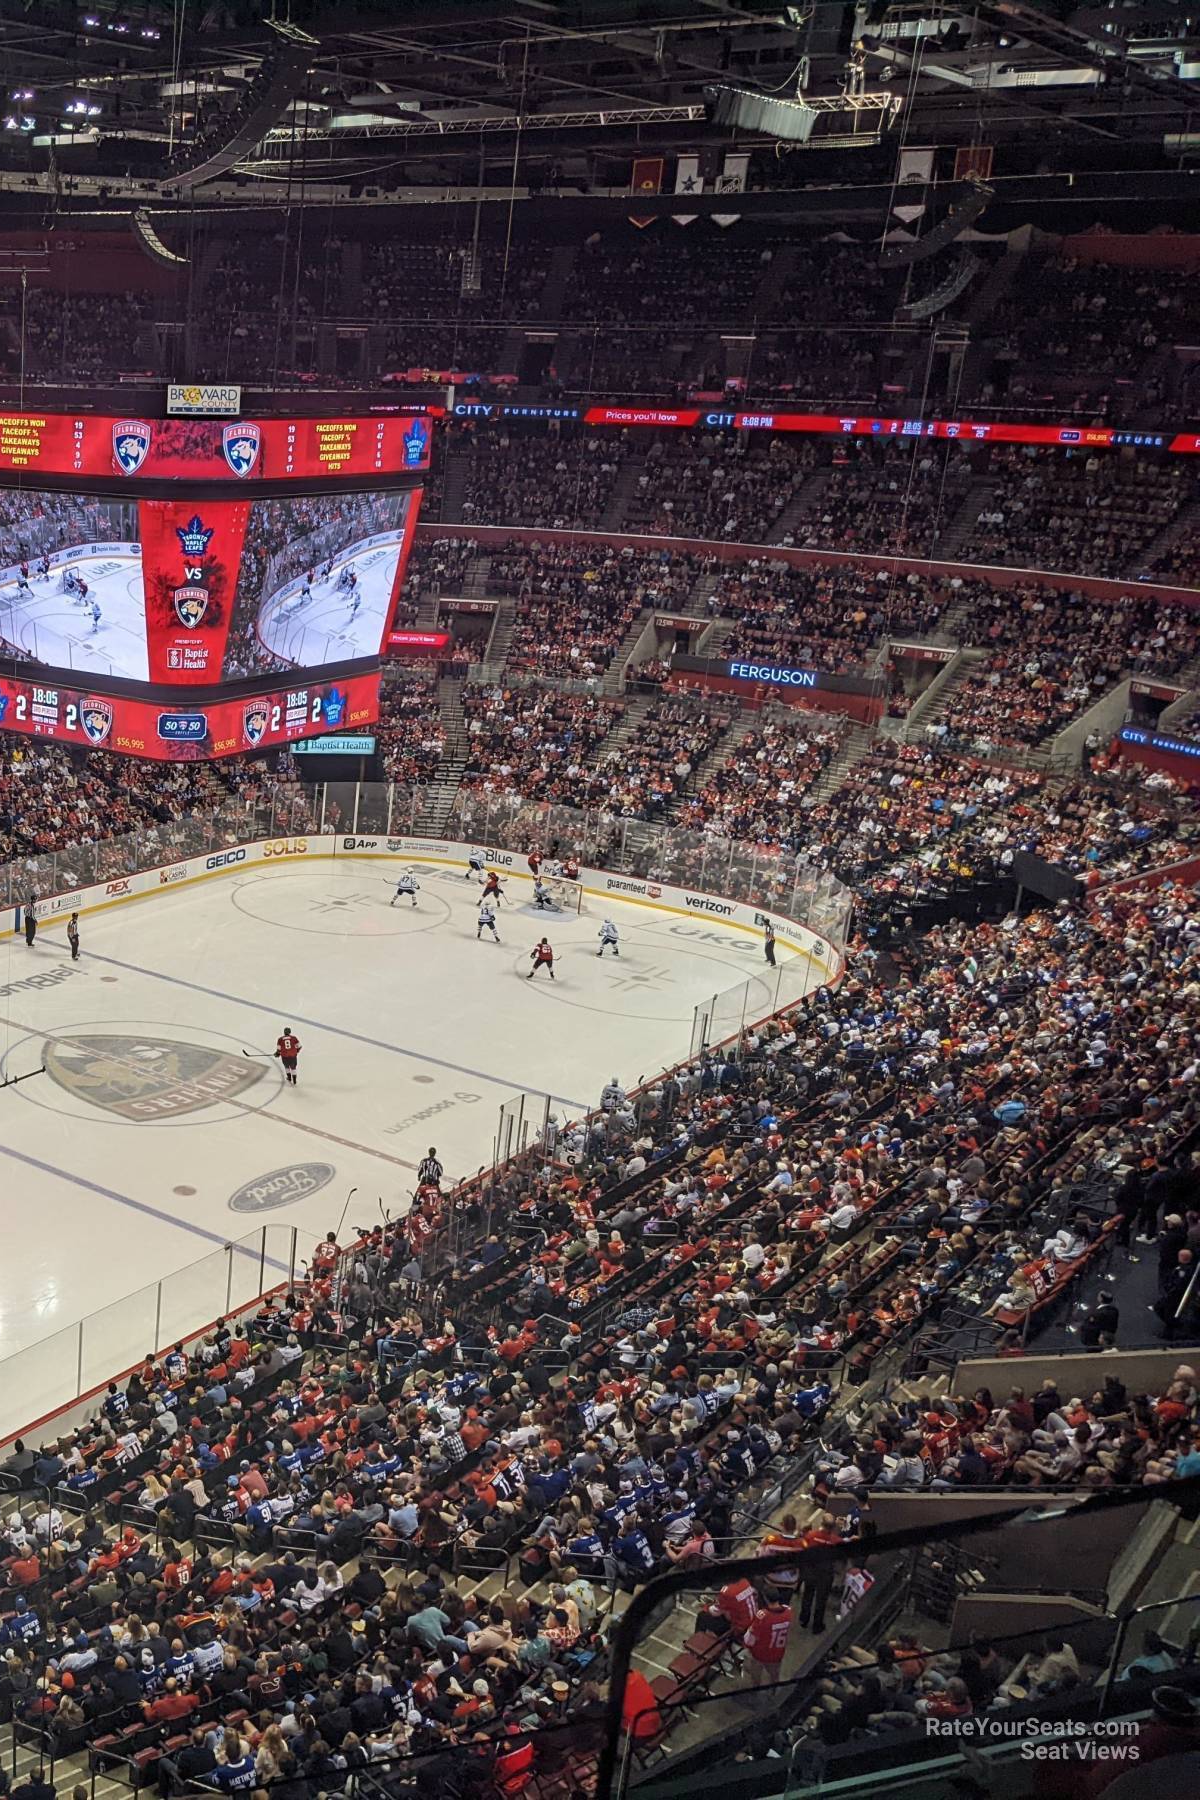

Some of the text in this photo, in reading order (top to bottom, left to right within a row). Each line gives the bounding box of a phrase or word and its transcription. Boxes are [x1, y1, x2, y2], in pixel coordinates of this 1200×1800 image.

[170, 388, 238, 402] BROWARD
[455, 405, 578, 418] CITY FURNITURE
[606, 411, 678, 423] Prices you'll love
[29, 419, 46, 427] WON
[74, 421, 84, 430] 19
[288, 425, 296, 433] 19
[316, 424, 357, 433] FACEOFFS WON
[377, 423, 385, 431] 17
[2, 427, 39, 437] FACEOFF %
[116, 425, 146, 436] FLORIDA
[228, 427, 257, 438] FLORIDA
[0, 436, 40, 447] TAKEAWAYS
[321, 434, 344, 442] FACEOFF
[0, 446, 40, 456] GIVEAWAYS
[319, 442, 351, 451] TAKEAWAYS
[11, 456, 28, 465] HITS
[319, 452, 351, 461] GIVEAWAYS
[73, 460, 82, 469] 17
[286, 464, 294, 472] 17
[327, 462, 342, 470] HITS
[182, 533, 208, 543] TORONTO
[91, 562, 122, 575] UKG
[184, 567, 202, 580] VS
[184, 648, 209, 660] Baptist
[184, 659, 207, 669] Health
[730, 663, 816, 687] FERGUSON
[32, 687, 58, 705] 18:05
[286, 690, 308, 708] 18:05
[16, 695, 27, 721] 2
[84, 701, 110, 713] FLORIDA
[312, 697, 321, 723] 2
[66, 704, 76, 730] 2
[271, 705, 280, 731] 2
[350, 709, 370, 722] $56,995
[164, 721, 200, 731] 50 50
[116, 736, 145, 750] $56,995
[1122, 730, 1147, 744] CITY
[214, 739, 236, 752] $56,995
[310, 738, 371, 751] Baptist Health
[263, 837, 307, 858] SOLIS
[357, 839, 377, 850] App
[206, 849, 246, 870] GEICO
[486, 848, 513, 866] Blue
[105, 879, 130, 895] DEX
[606, 877, 646, 895] guaranteed
[685, 896, 732, 916] verizon
[669, 925, 759, 951] UKG
[284, 1040, 291, 1050] 8
[132, 1064, 249, 1113] PANTHERS
[567, 1155, 576, 1166] G
[246, 1168, 318, 1204] Ford
[769, 1629, 787, 1648] 16
